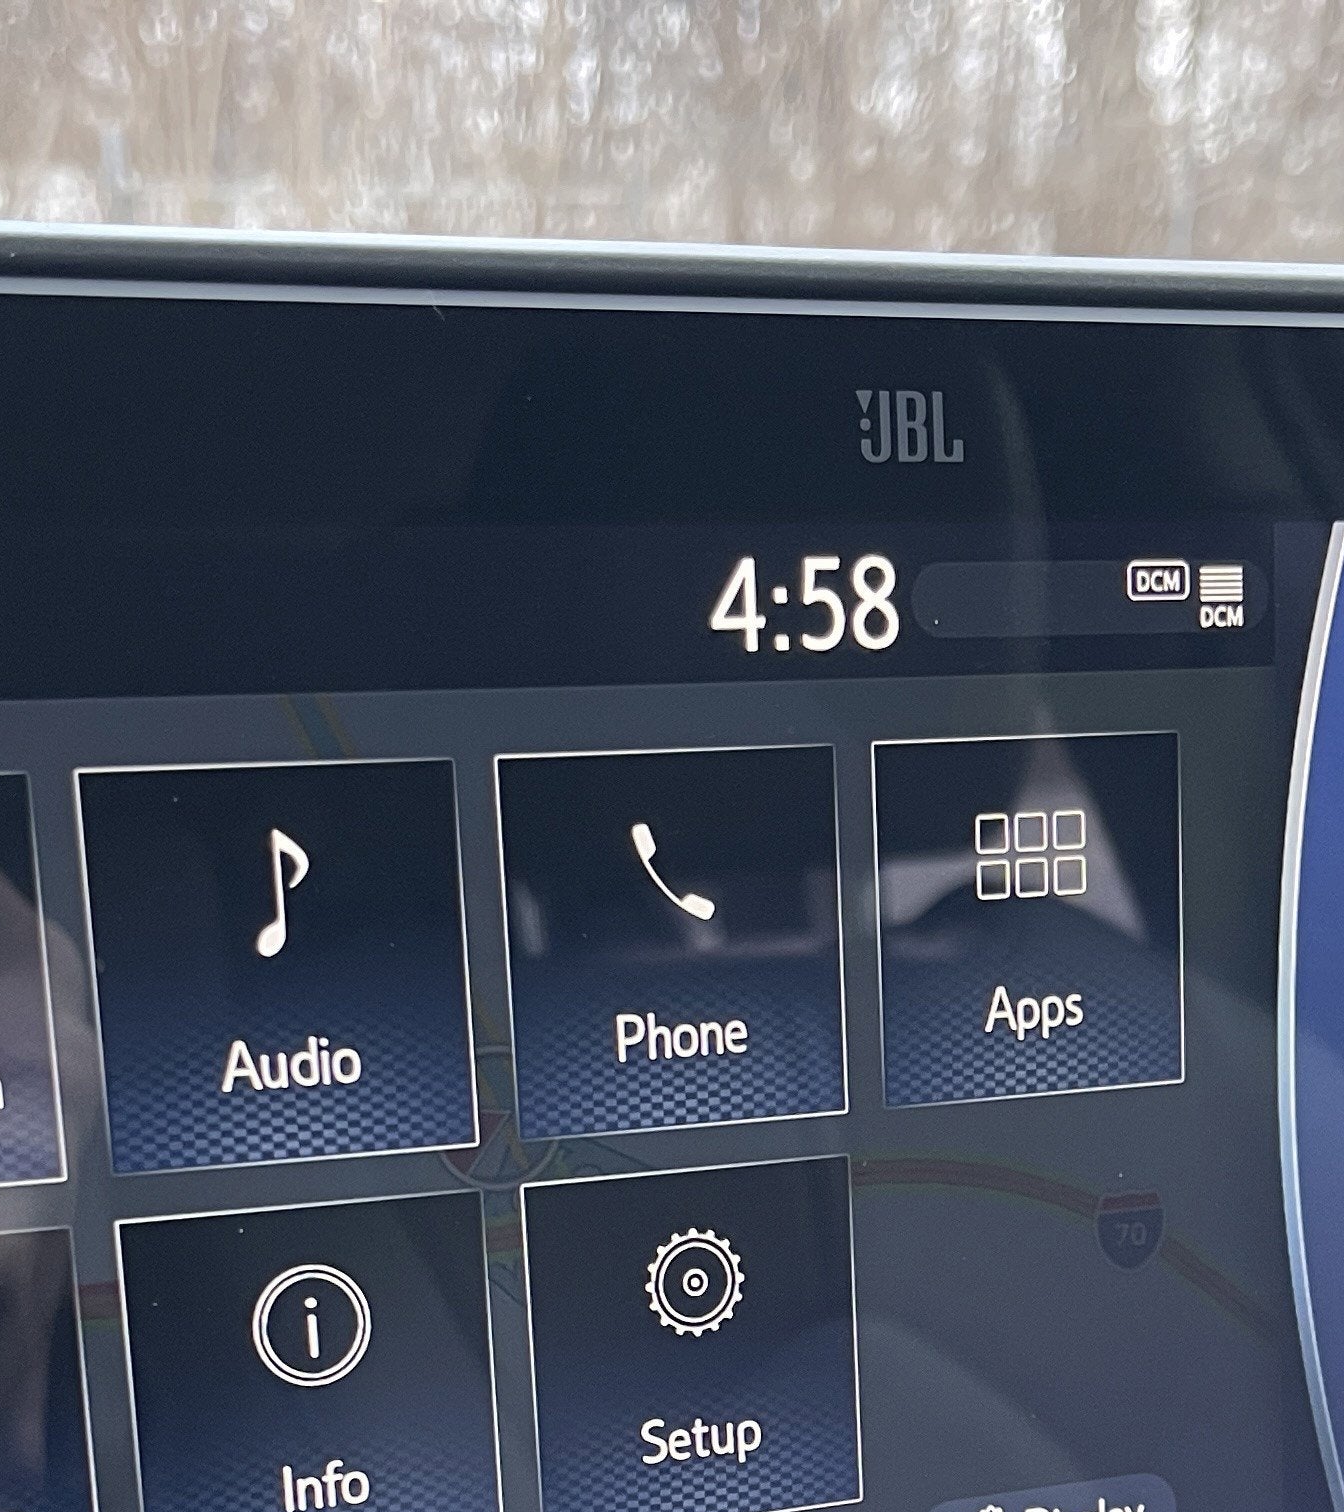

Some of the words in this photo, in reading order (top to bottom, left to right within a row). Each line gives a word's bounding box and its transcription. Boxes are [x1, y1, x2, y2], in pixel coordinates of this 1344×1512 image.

[857, 390, 964, 463] JBL
[709, 553, 901, 653] 4:58
[1136, 568, 1181, 593] DCM
[1199, 604, 1245, 629] DCM
[982, 978, 1085, 1040] Apps
[614, 1011, 749, 1063] Phone
[221, 1035, 363, 1094] Audio
[1115, 1221, 1148, 1248] 70
[639, 1416, 763, 1466] Setup
